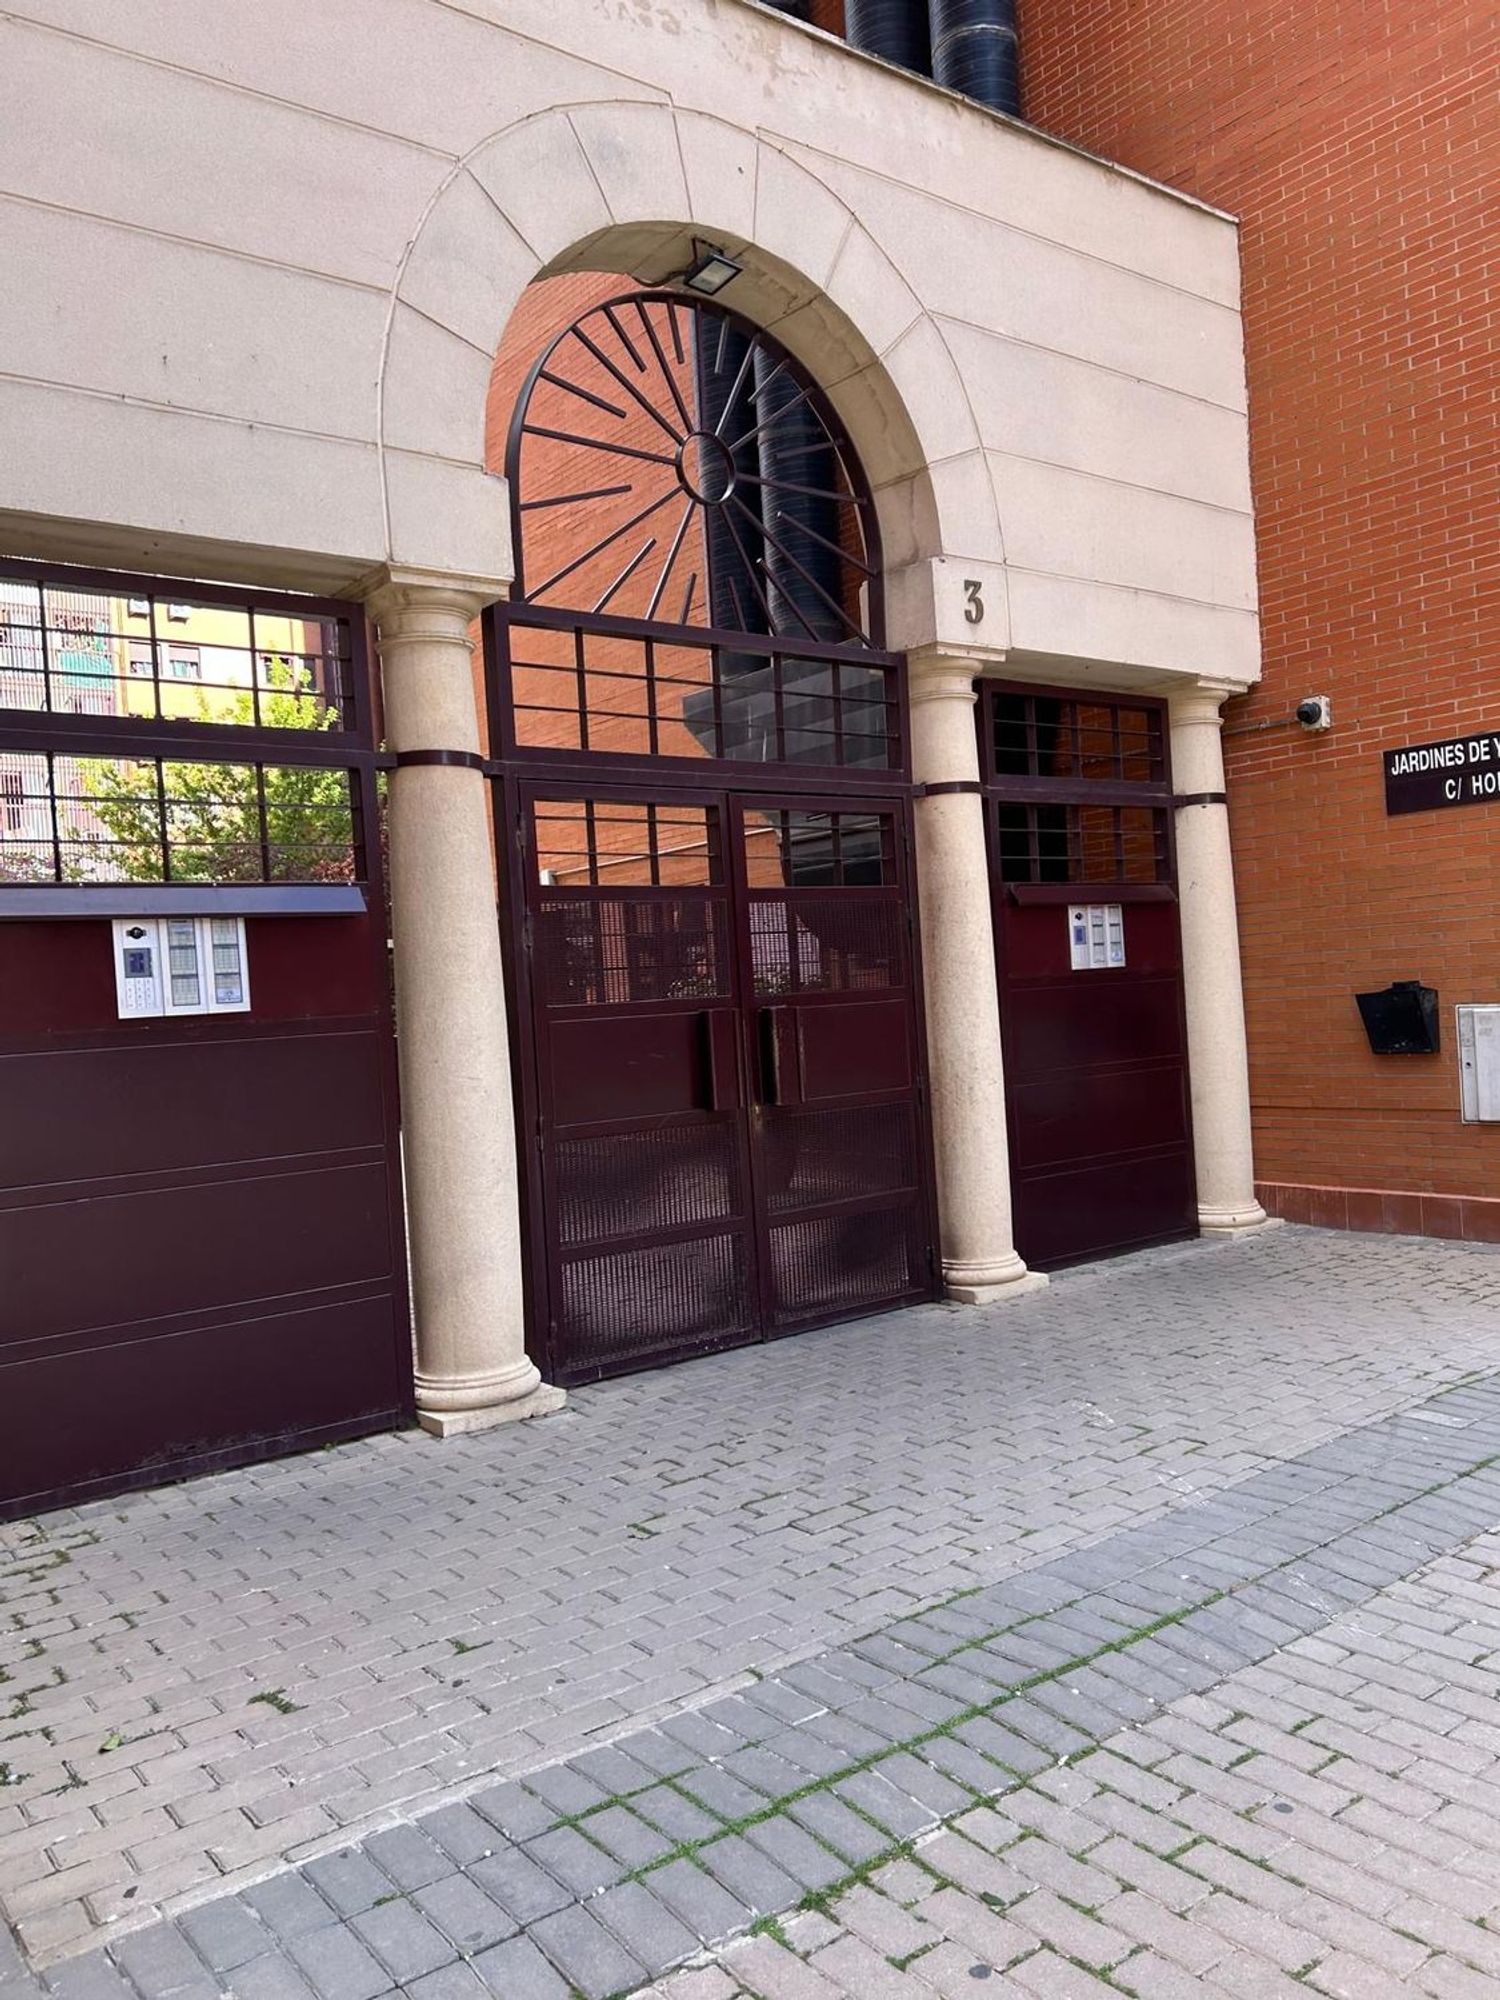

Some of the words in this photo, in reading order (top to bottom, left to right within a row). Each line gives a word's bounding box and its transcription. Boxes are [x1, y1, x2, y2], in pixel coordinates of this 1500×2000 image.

[964, 579, 984, 624] 3
[1391, 743, 1465, 775] JARDINES
[1468, 739, 1491, 762] DE
[1445, 777, 1462, 800] C/
[1472, 771, 1500, 795] HO
